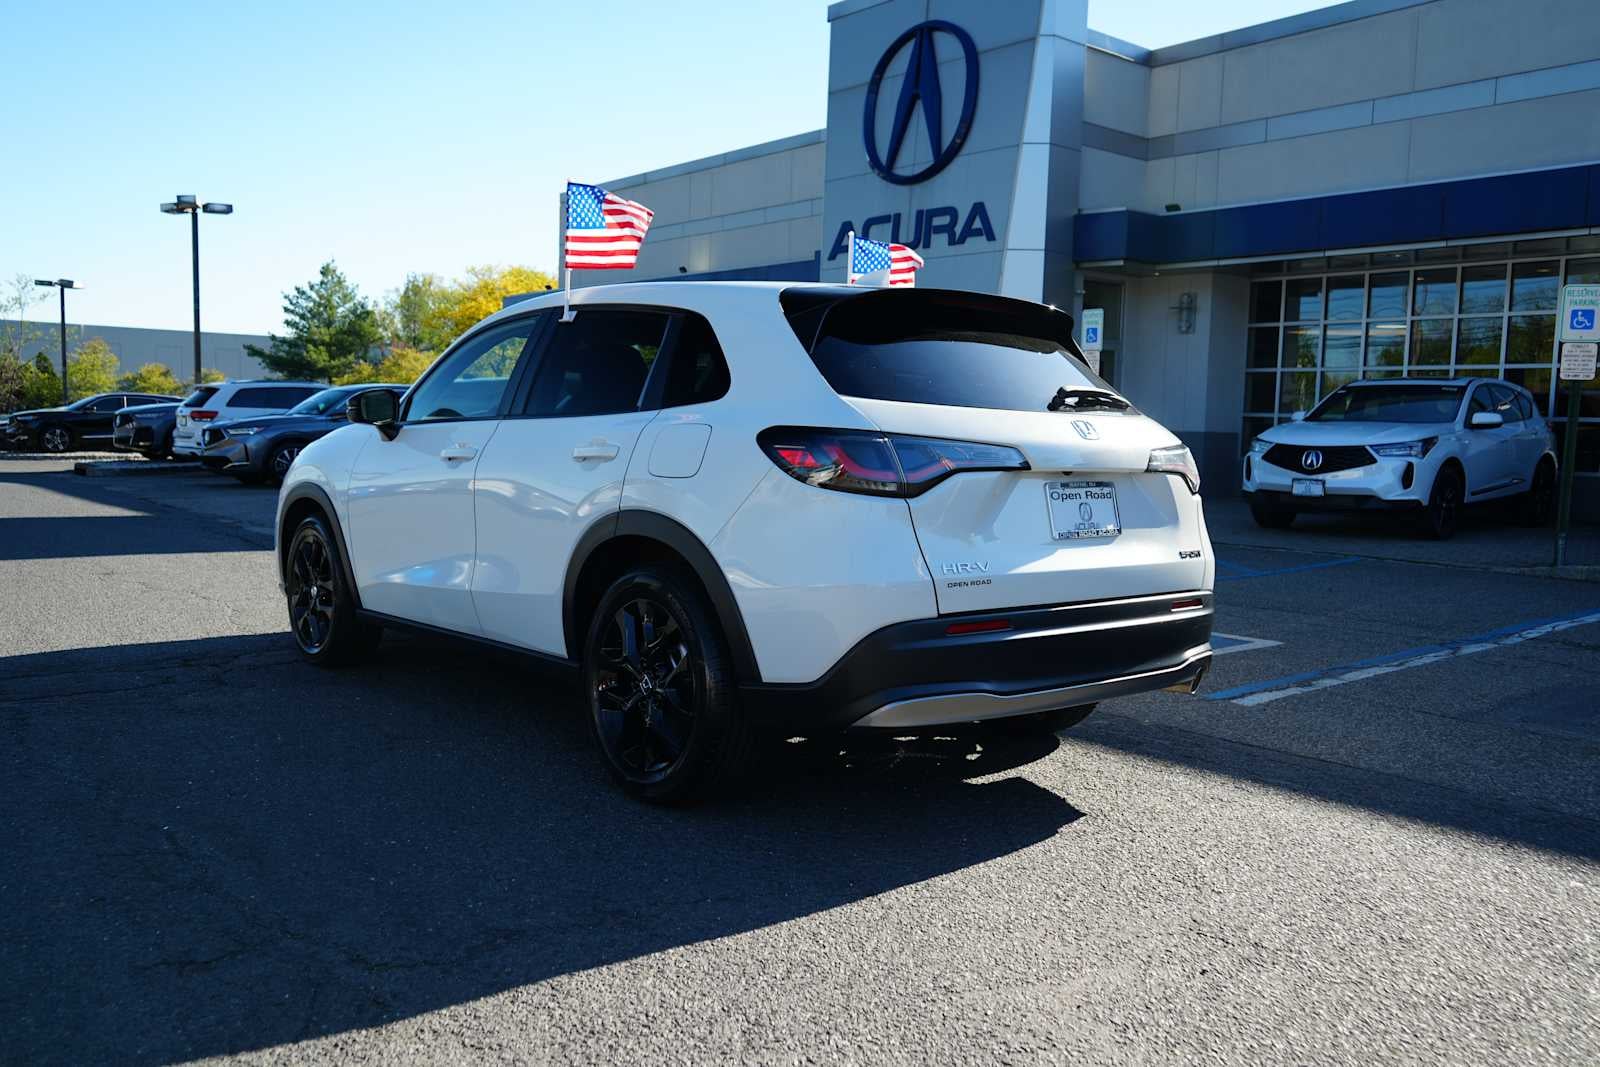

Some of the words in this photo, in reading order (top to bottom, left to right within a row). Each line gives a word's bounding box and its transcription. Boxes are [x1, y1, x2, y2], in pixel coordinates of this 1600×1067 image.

[827, 201, 996, 261] ACURA
[1051, 491, 1082, 502] Open
[1085, 490, 1112, 499] Road
[941, 561, 989, 575] HR-V
